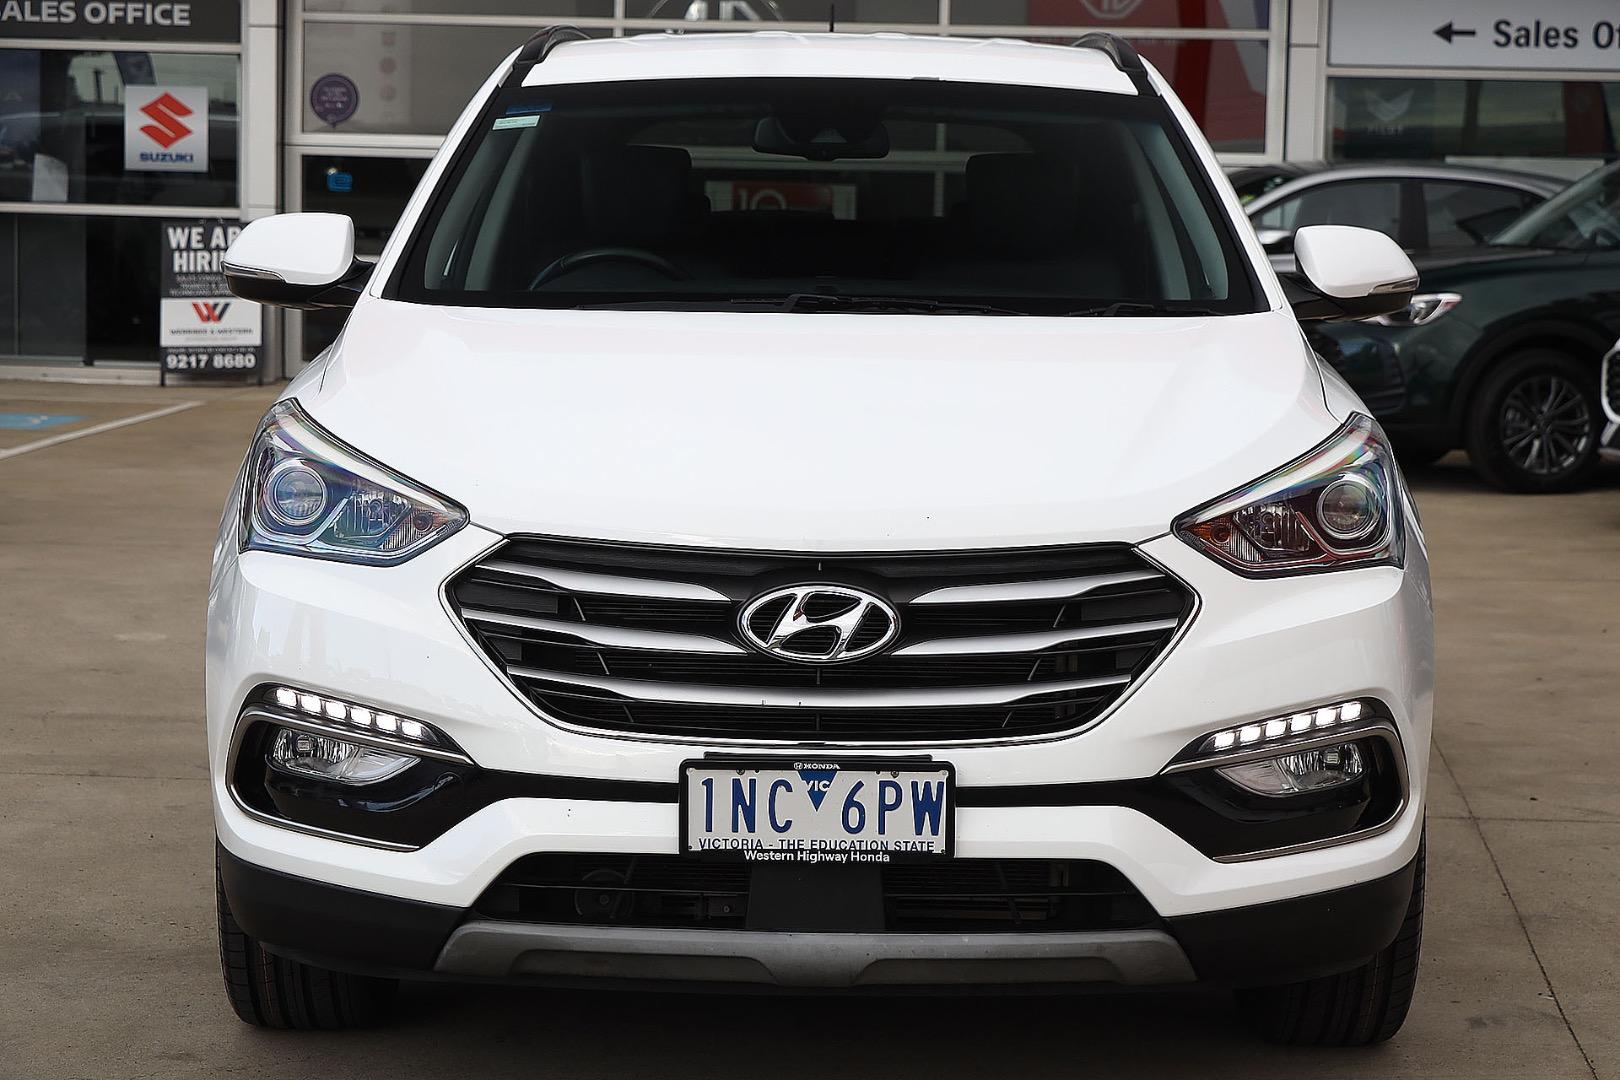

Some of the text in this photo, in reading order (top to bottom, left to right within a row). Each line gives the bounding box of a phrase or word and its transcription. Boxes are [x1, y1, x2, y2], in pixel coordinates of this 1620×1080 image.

[84, 3, 192, 26] OFFICE
[1493, 19, 1579, 49] Sales
[140, 152, 194, 163] SUZUKI
[167, 226, 205, 250] WE
[166, 353, 209, 369] 9217
[701, 778, 945, 836] 1NC 6PW
[699, 838, 764, 851] VICTORIA
[778, 839, 804, 850] THE
[811, 839, 889, 851] EDUCATION
[894, 840, 935, 852] STATE
[744, 849, 890, 863] Western Highway Honda
